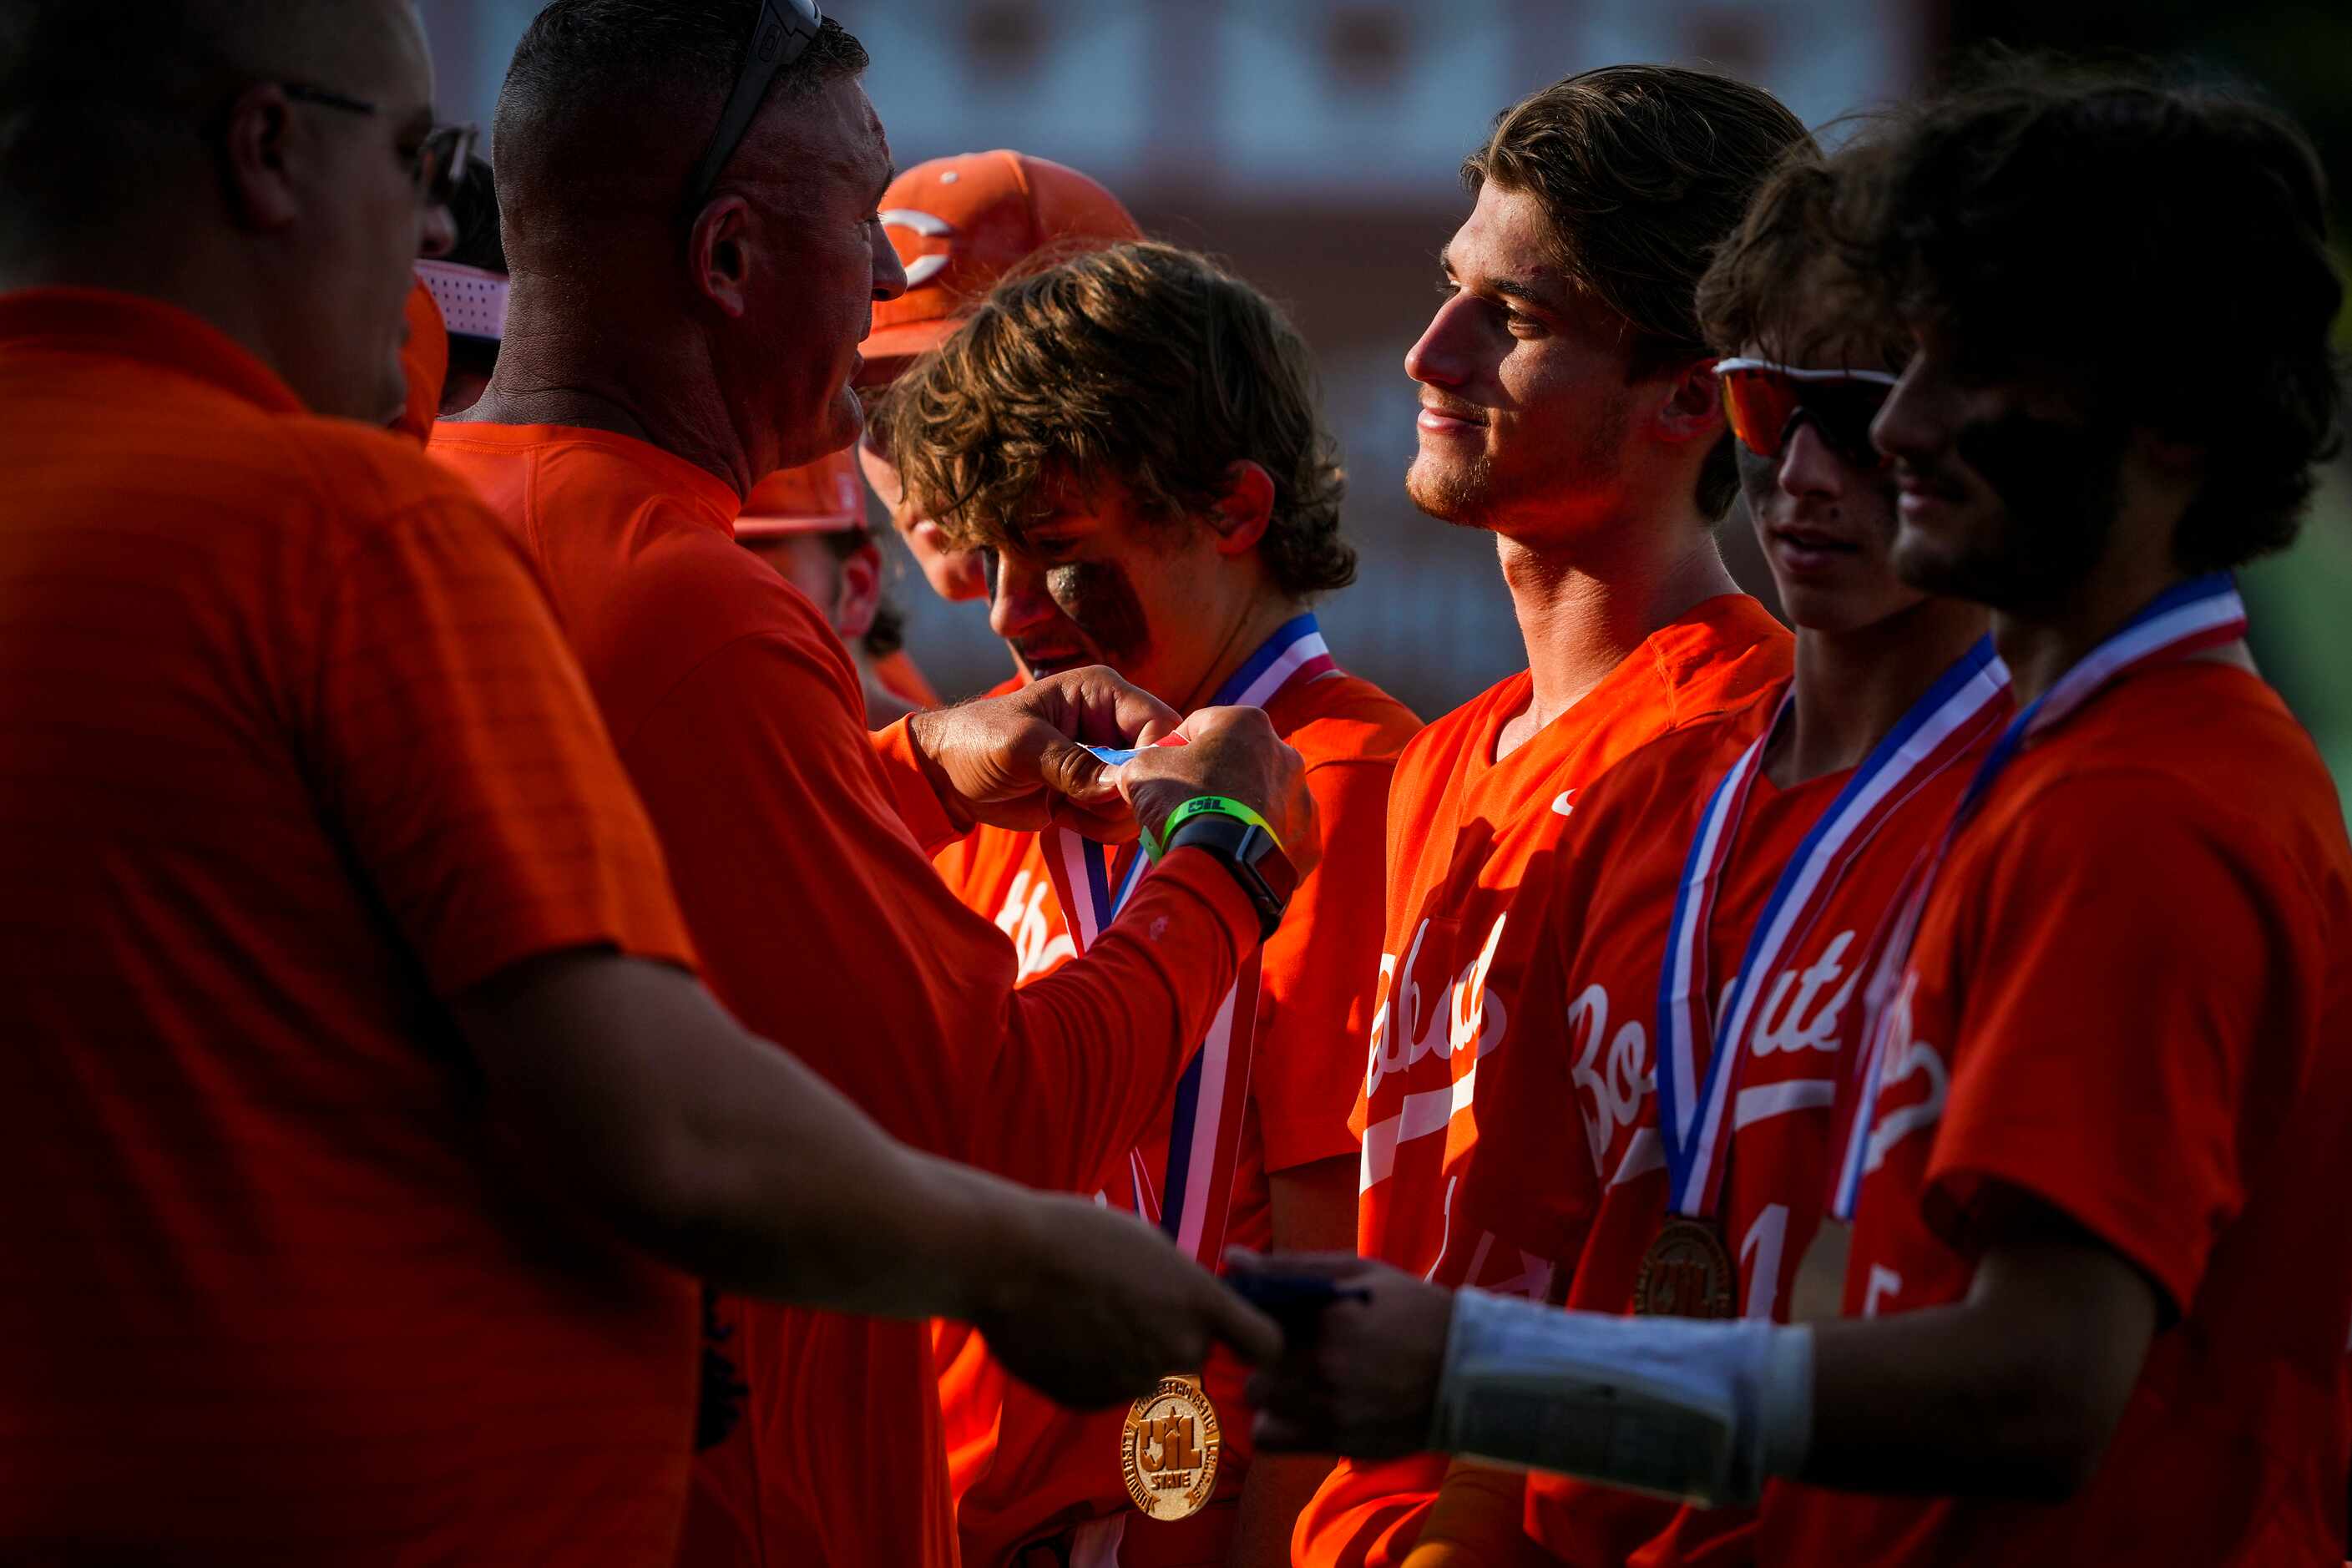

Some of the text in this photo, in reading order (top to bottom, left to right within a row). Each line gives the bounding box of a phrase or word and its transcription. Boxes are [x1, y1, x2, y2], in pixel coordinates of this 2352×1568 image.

[1188, 797, 1227, 813] UIL
[1139, 1406, 1202, 1472] UIL
[1122, 1428, 1151, 1508] UNIVERSITY
[1151, 1471, 1191, 1490] STATE
